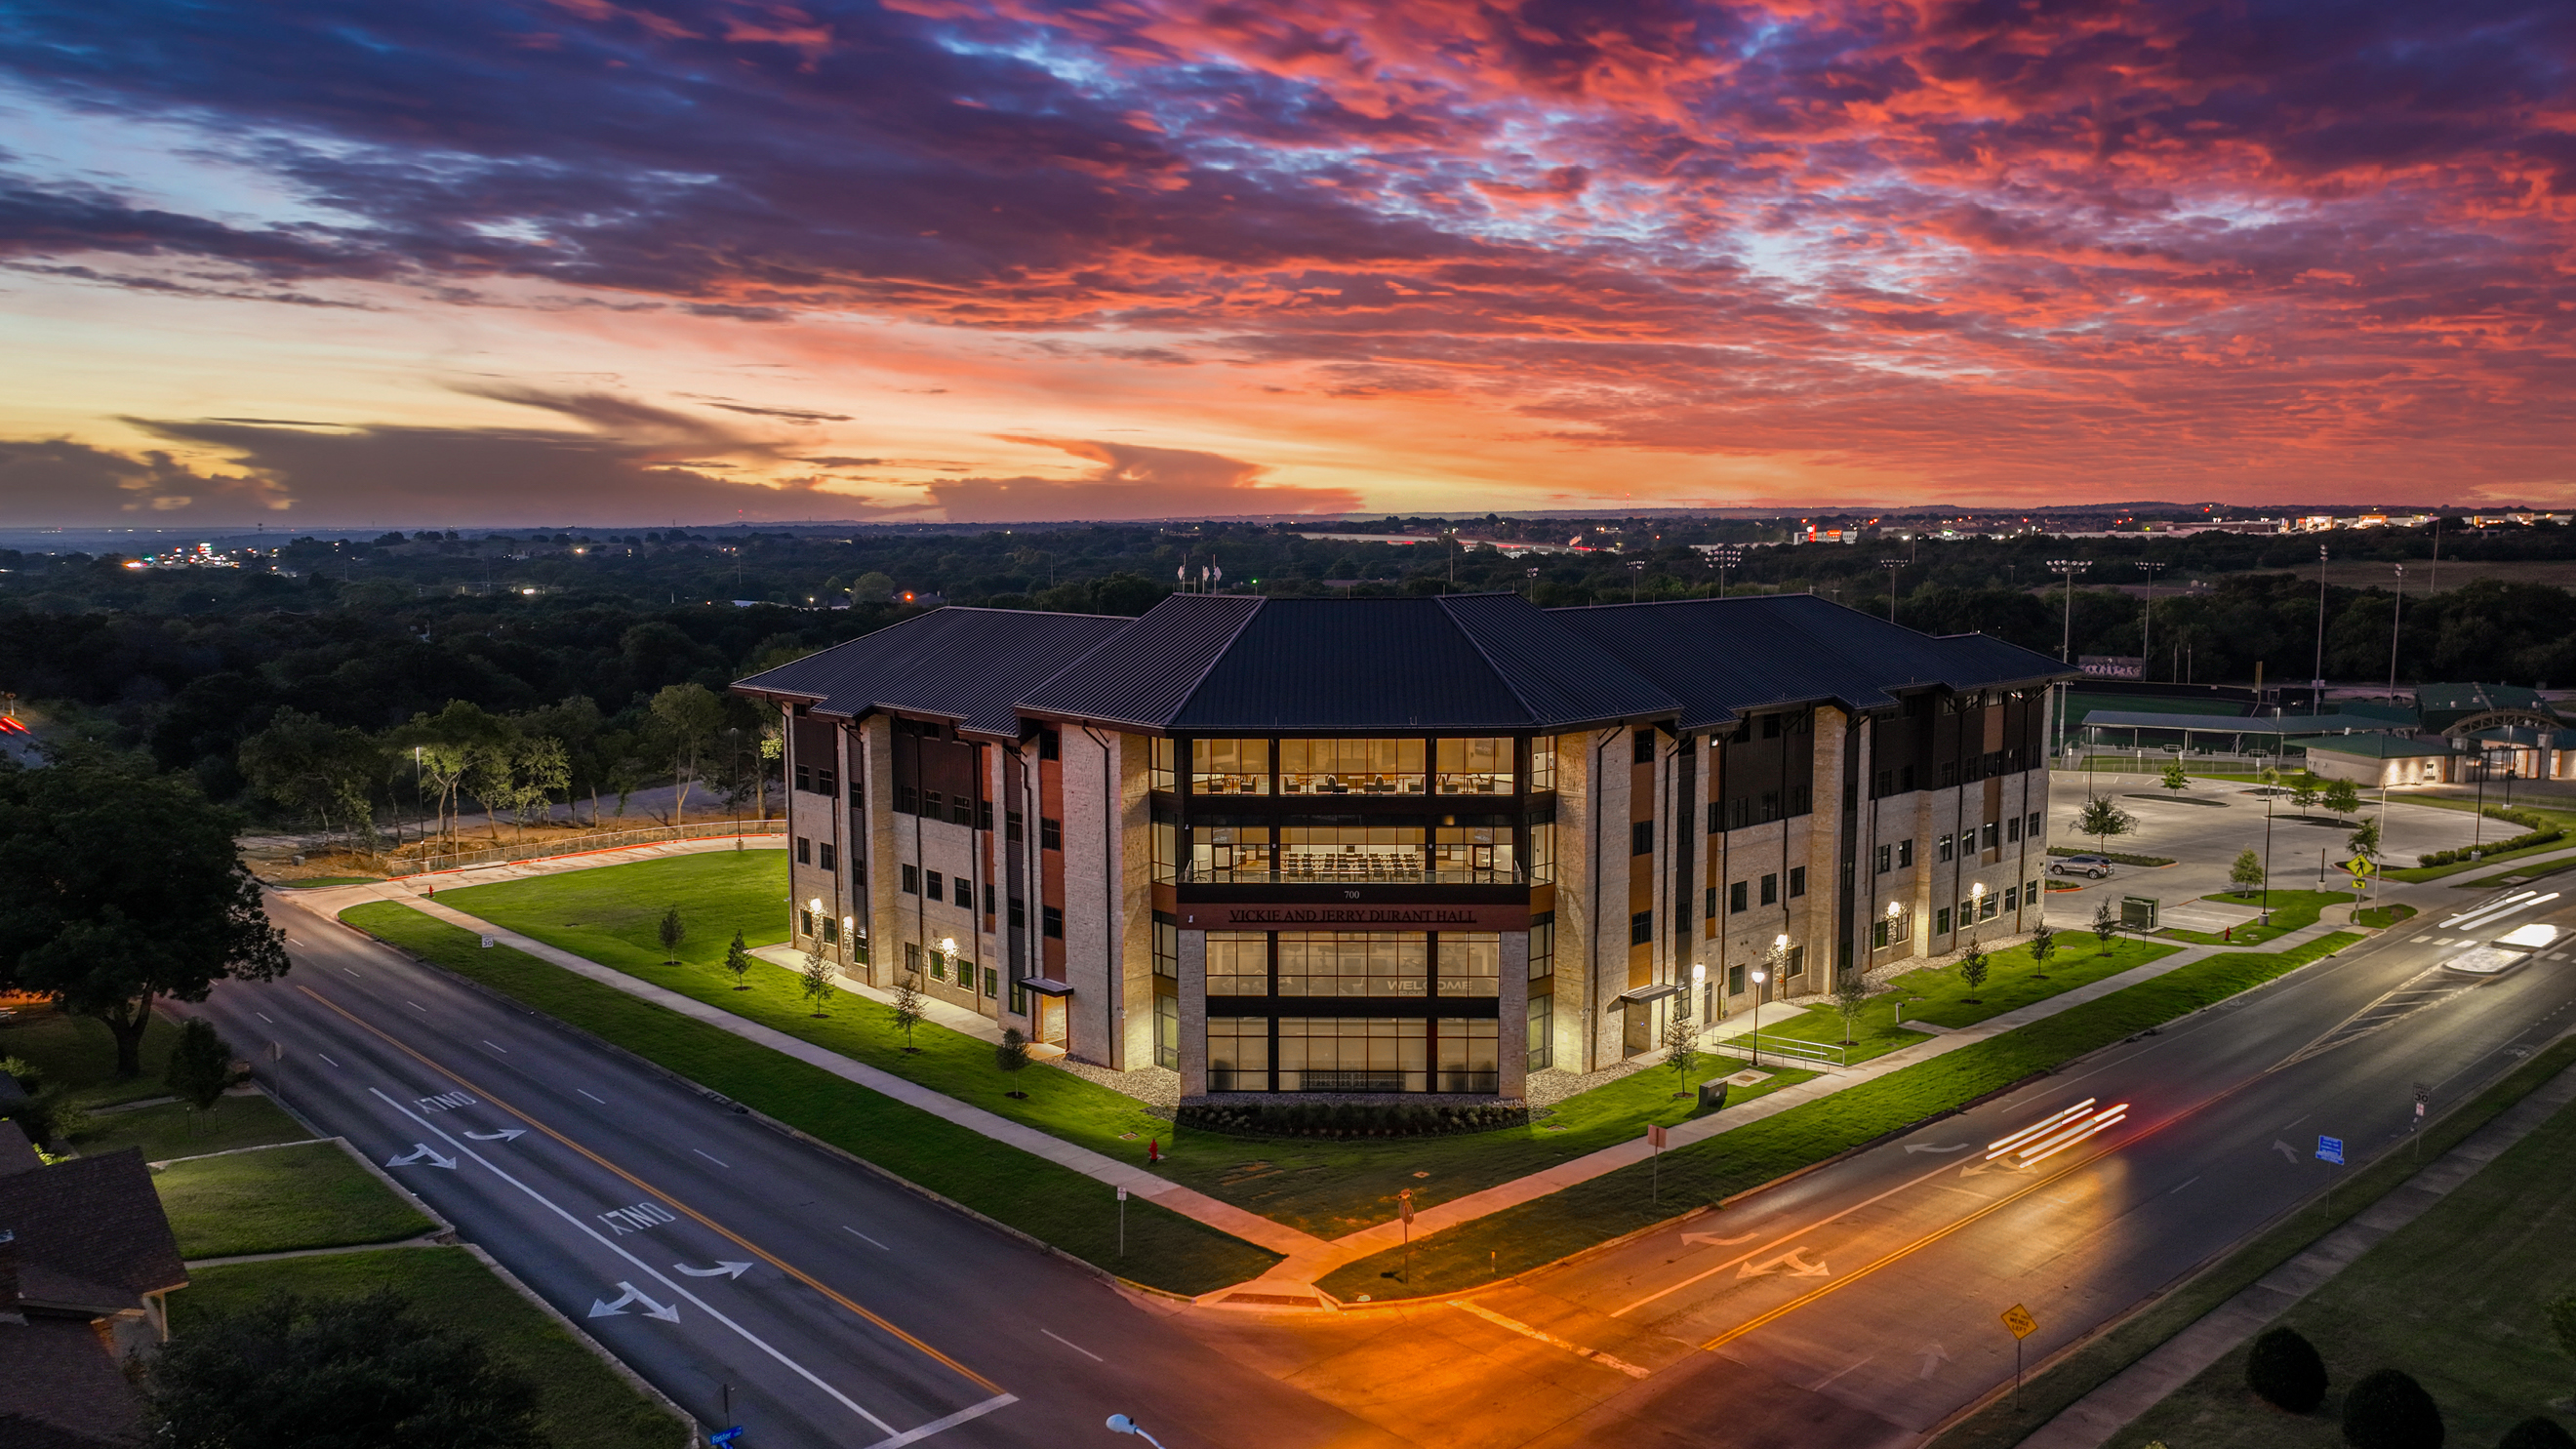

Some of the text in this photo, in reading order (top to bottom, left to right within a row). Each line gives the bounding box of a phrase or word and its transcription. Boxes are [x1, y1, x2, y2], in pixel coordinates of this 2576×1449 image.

[1344, 890, 1360, 900] 700
[1229, 909, 1477, 922] VICKIE AND JERRY DURANT HALL
[413, 1091, 477, 1114] ONLY
[2414, 1093, 2429, 1103] 30
[596, 1202, 676, 1236] ONLY
[2012, 1324, 2027, 1334] LEFT
